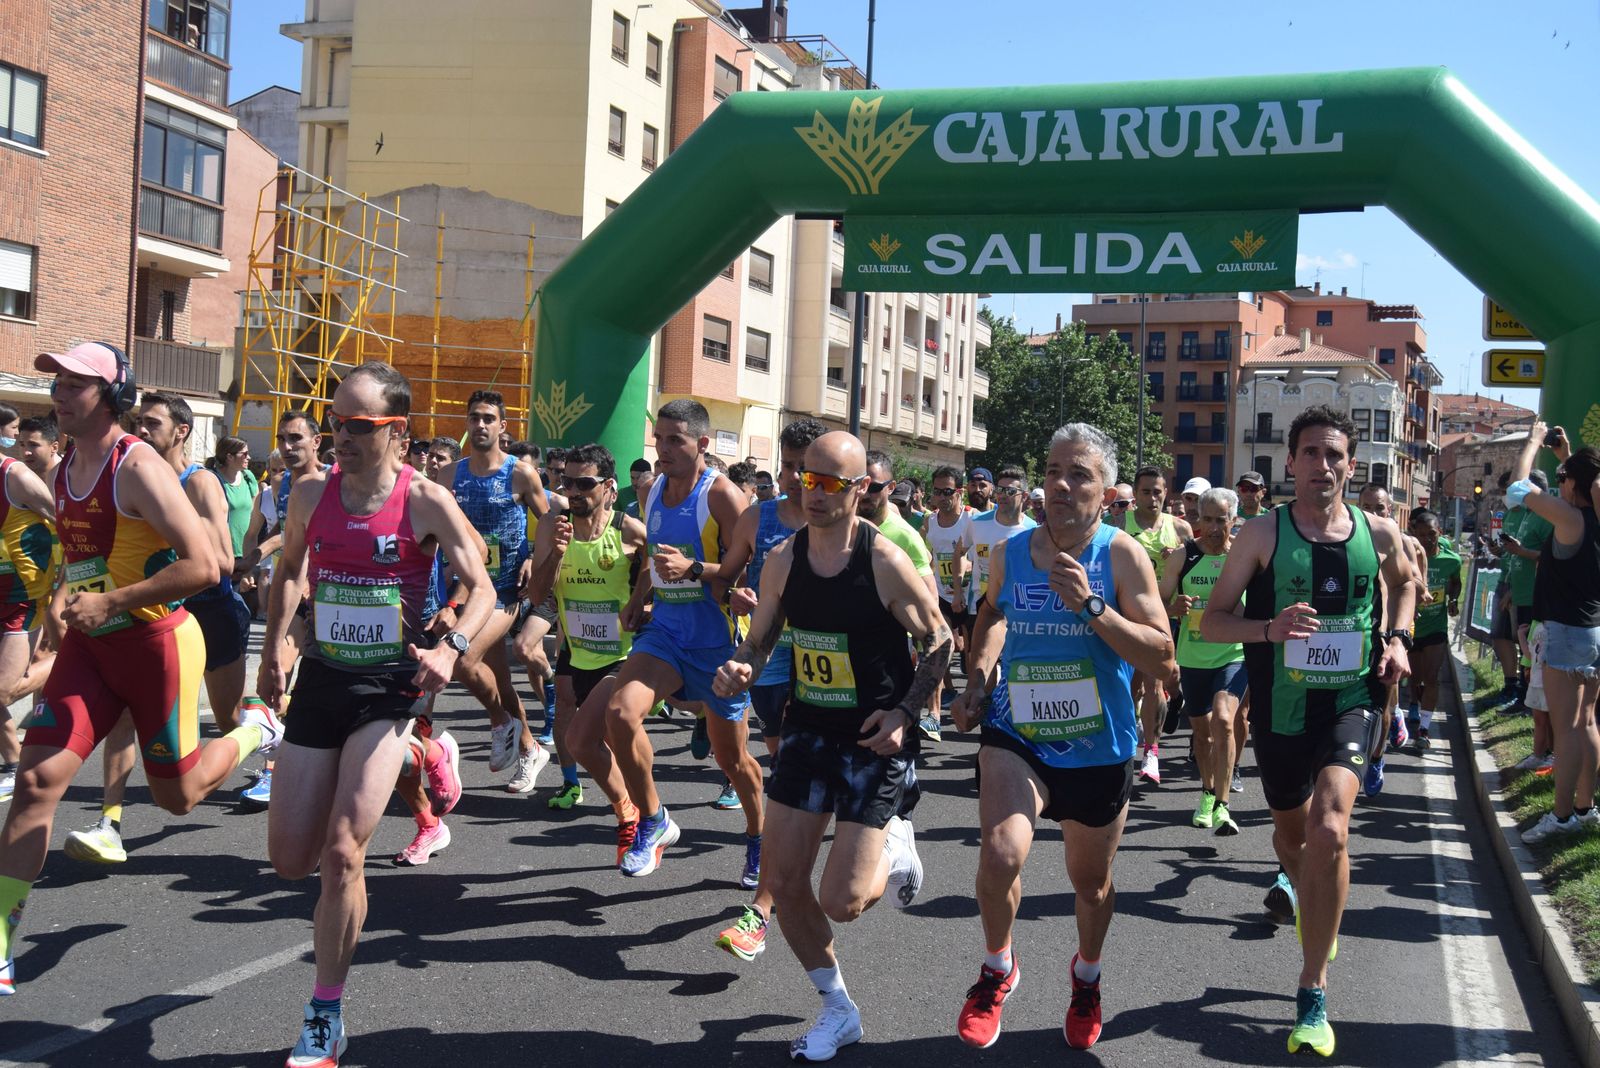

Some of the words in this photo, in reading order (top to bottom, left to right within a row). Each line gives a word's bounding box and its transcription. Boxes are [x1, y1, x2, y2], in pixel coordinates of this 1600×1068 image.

[933, 110, 1092, 166] CAJA
[1099, 99, 1344, 160] RURAL
[923, 231, 1203, 275] SALIDA
[857, 264, 879, 273] CAJA
[880, 264, 912, 274] RURAL
[1216, 263, 1241, 273] CAJA
[1241, 262, 1278, 271] RURAL
[577, 575, 606, 585] BAÑEZA
[1190, 575, 1209, 585] MESA
[339, 588, 390, 598] FUNDACION
[360, 597, 390, 605] RURAL
[1319, 618, 1356, 626] NDACION
[330, 621, 384, 643] GARGAR
[581, 623, 608, 638] JORGE
[1011, 621, 1095, 637] ATLETISMO
[1330, 624, 1356, 633] RURAL
[799, 632, 838, 644] FUNDACION
[597, 643, 619, 651] RURAL
[815, 642, 839, 651] RURAL
[363, 647, 397, 659] RURAL
[1306, 643, 1342, 667] PEÓN
[802, 653, 833, 685] 49
[1030, 663, 1081, 674] FUNDACION
[1031, 672, 1052, 681] CAJA
[1053, 671, 1083, 680] RURAL
[1305, 674, 1328, 684] CAJA
[1329, 673, 1356, 684] RURAL
[823, 693, 853, 702] RURAL
[1031, 699, 1080, 721] MANSO
[1039, 727, 1064, 736] CAJA
[1065, 720, 1099, 734] RURAL
